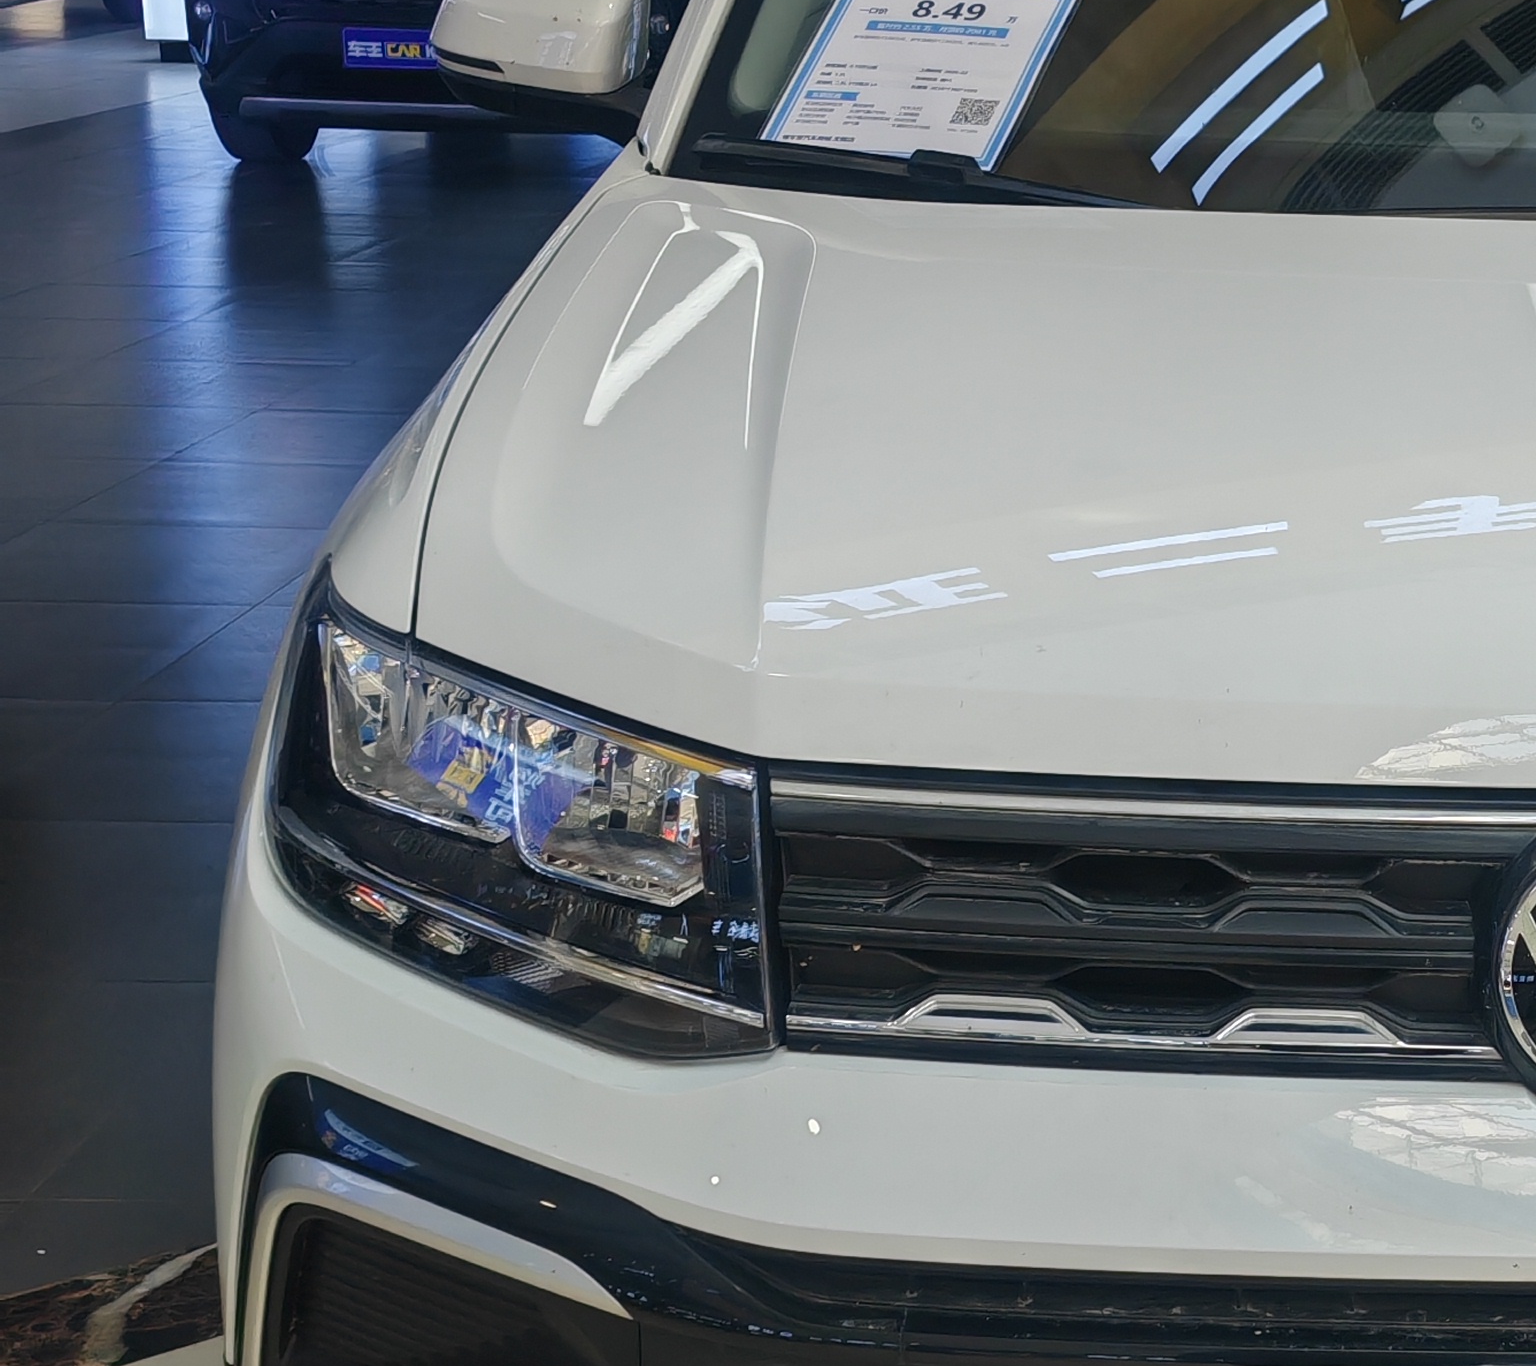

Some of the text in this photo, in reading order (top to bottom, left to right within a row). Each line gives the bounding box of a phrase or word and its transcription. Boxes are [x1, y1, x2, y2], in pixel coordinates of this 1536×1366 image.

[912, 0, 987, 21] 8.49
[1007, 15, 1019, 24] 万
[347, 41, 383, 57] 车王
[386, 42, 421, 59] CAR
